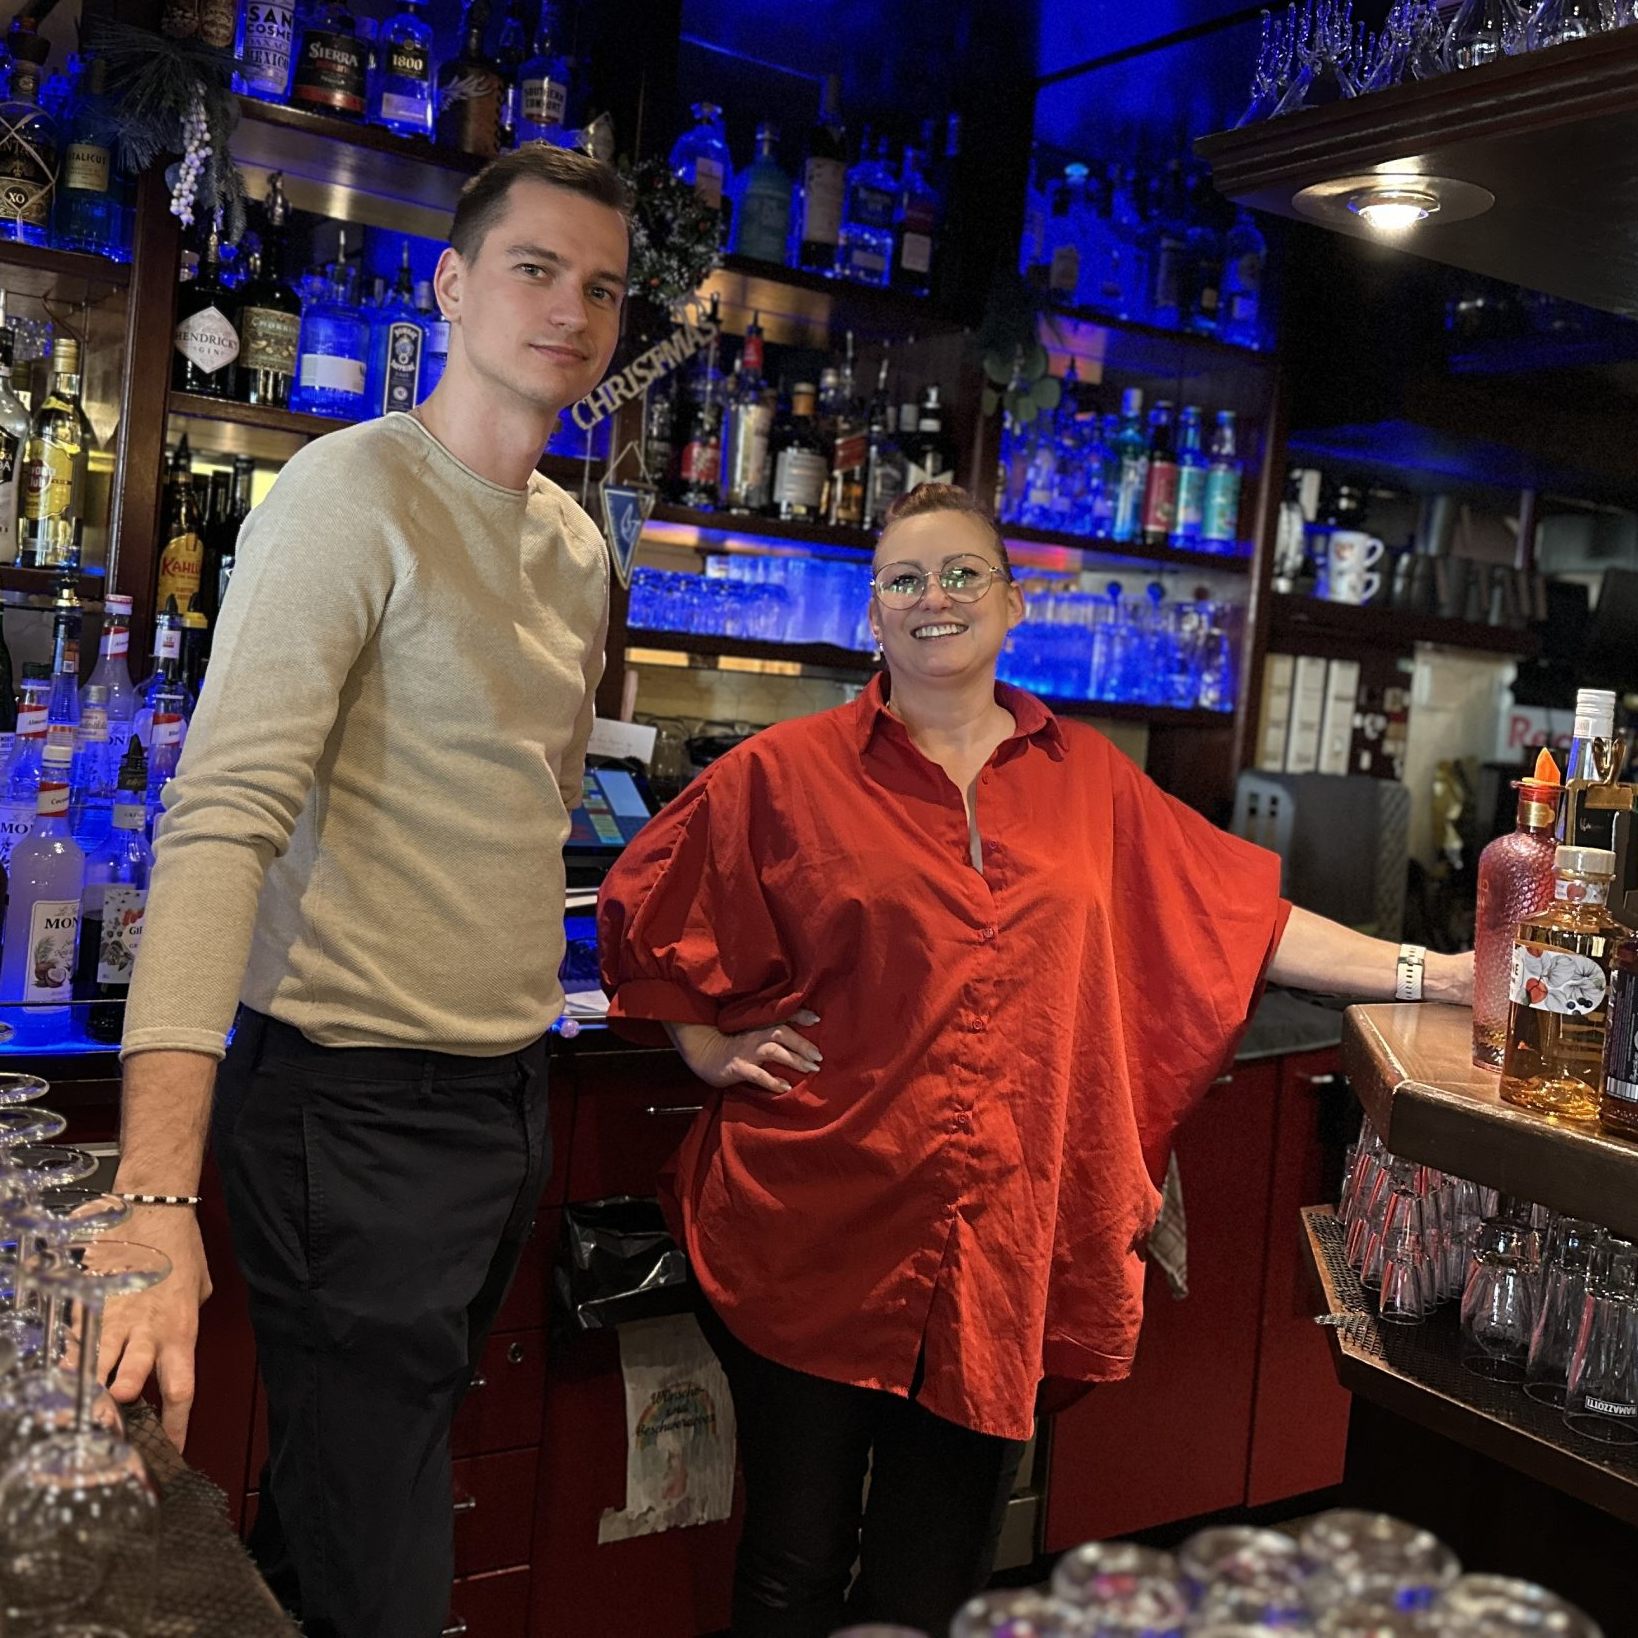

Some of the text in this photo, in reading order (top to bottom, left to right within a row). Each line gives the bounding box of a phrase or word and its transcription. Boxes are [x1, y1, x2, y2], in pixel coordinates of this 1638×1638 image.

[248, 5, 292, 29] SAN
[309, 41, 359, 68] SIERRA
[392, 54, 424, 71] 1800
[9, 192, 26, 205] XO
[572, 320, 717, 430] CHRISTMAS
